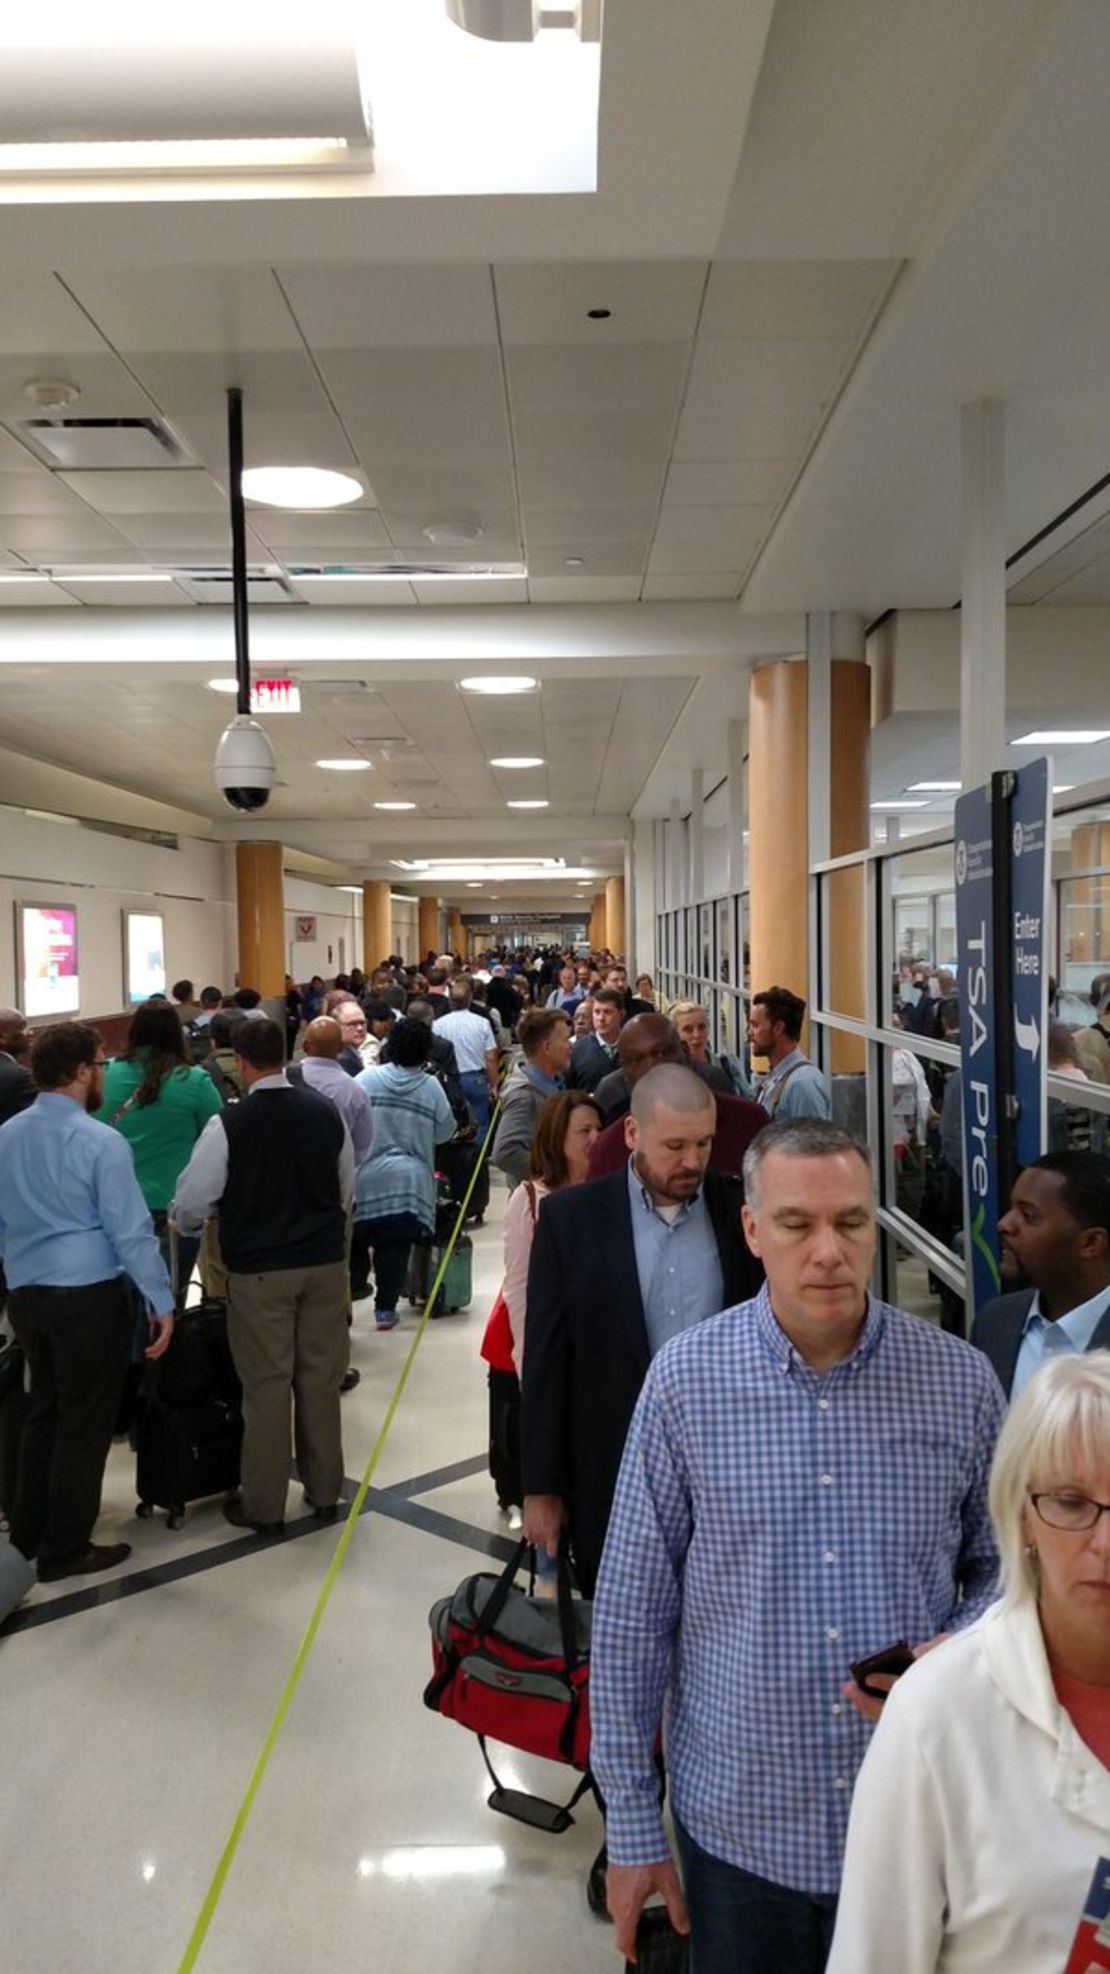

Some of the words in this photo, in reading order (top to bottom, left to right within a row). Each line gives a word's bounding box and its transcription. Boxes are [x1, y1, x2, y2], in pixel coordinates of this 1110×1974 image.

[255, 680, 292, 708] EXIT
[1015, 912, 1040, 939] Enter
[1015, 947, 1039, 975] Here
[967, 920, 987, 1057] TSA
